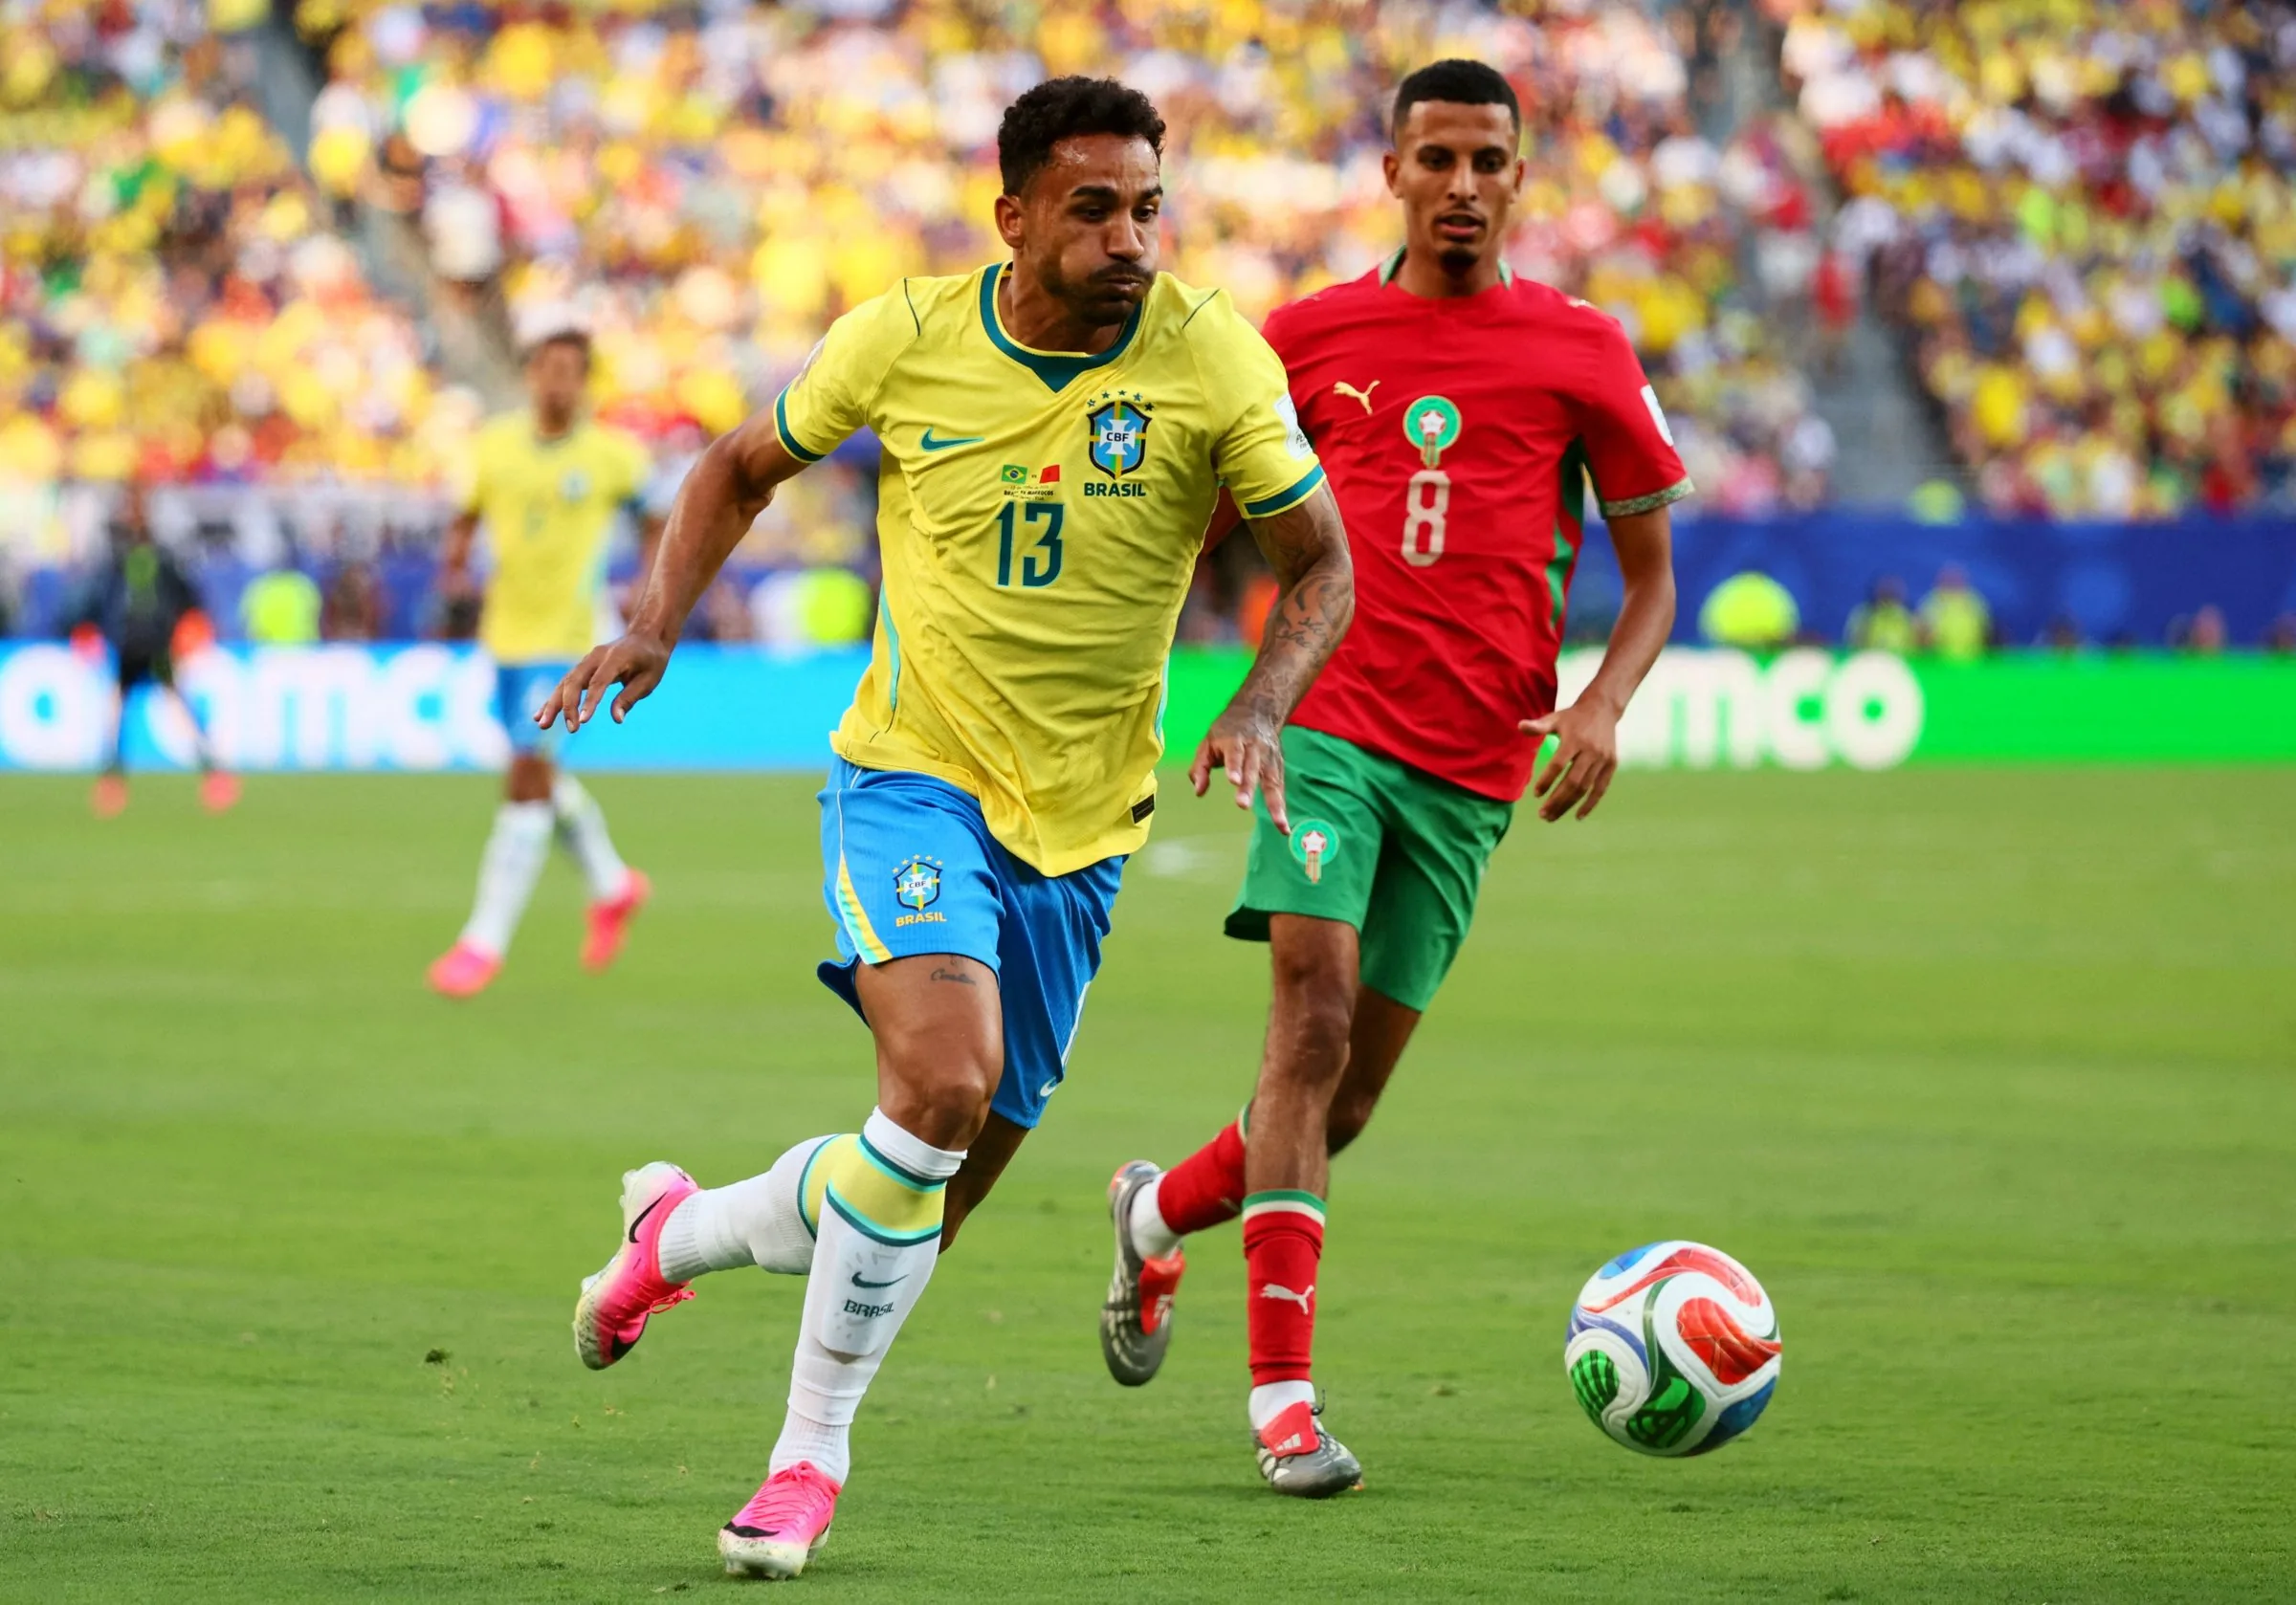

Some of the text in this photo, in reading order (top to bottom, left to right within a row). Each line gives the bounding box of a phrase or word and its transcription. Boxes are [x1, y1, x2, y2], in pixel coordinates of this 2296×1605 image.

[1106, 431, 1130, 443] CBF
[1083, 482, 1147, 497] BRASIL
[1401, 470, 1451, 567] 8
[995, 500, 1066, 588] 13
[908, 880, 927, 890] CBF
[895, 912, 947, 927] BRASIL
[843, 1298, 895, 1318] BRASIL
